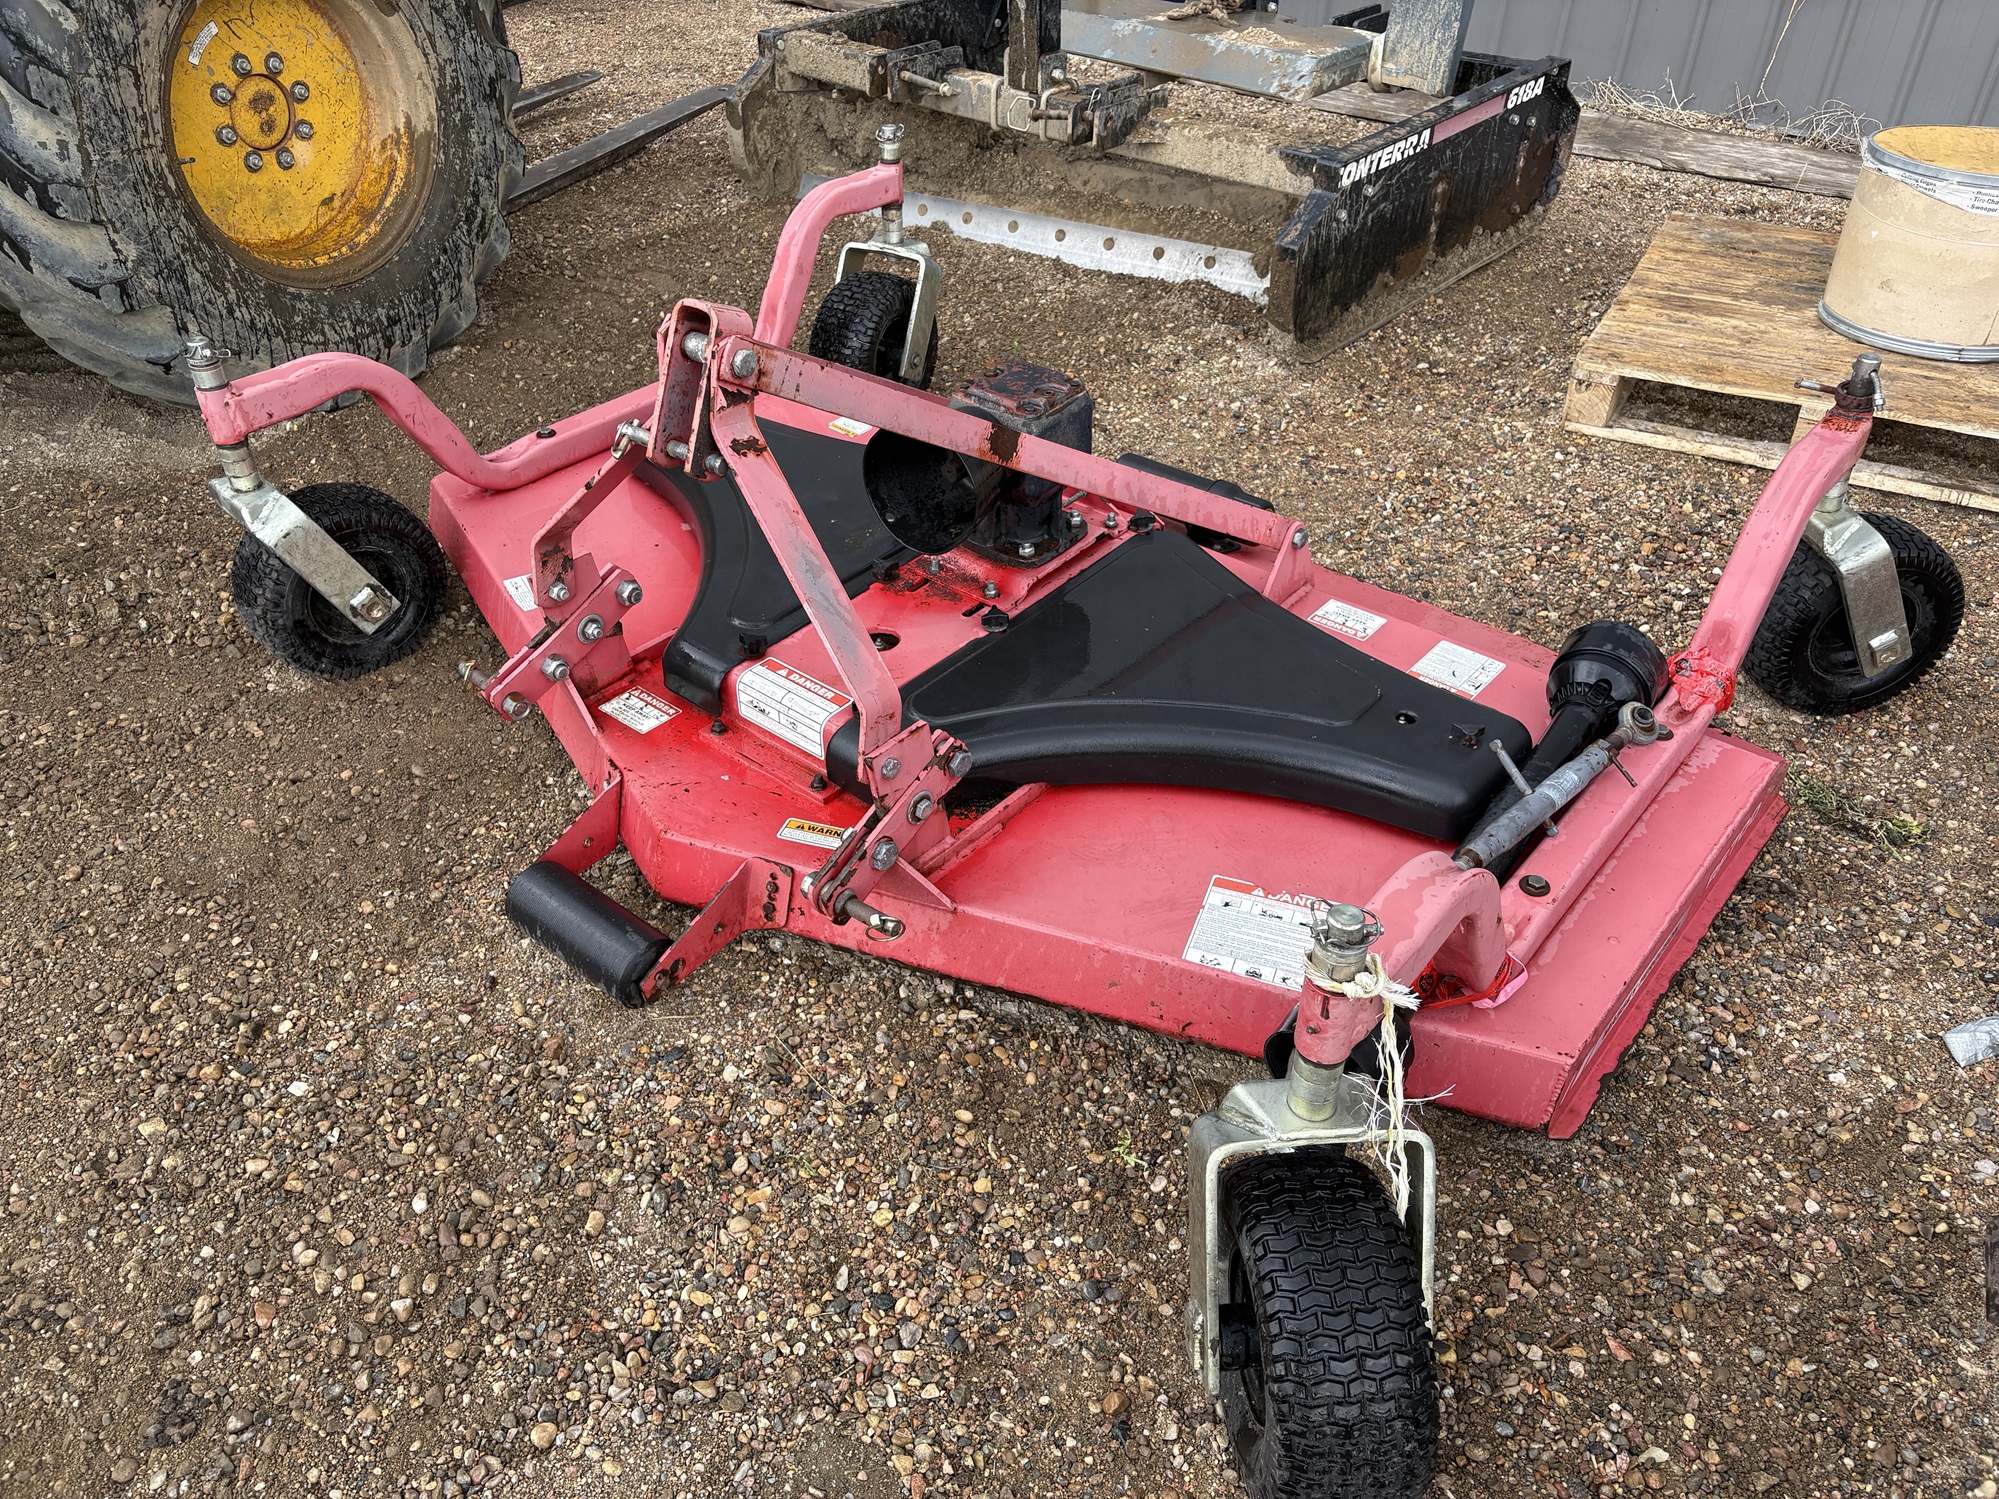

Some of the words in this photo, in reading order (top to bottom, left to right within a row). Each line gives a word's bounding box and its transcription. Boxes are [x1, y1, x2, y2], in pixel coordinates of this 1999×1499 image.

[1507, 76, 1545, 110] 618A
[1312, 615, 1356, 637] DANGER
[788, 671, 835, 700] DANGER
[639, 693, 677, 716] DANGER
[1267, 892, 1331, 911] ANGE
